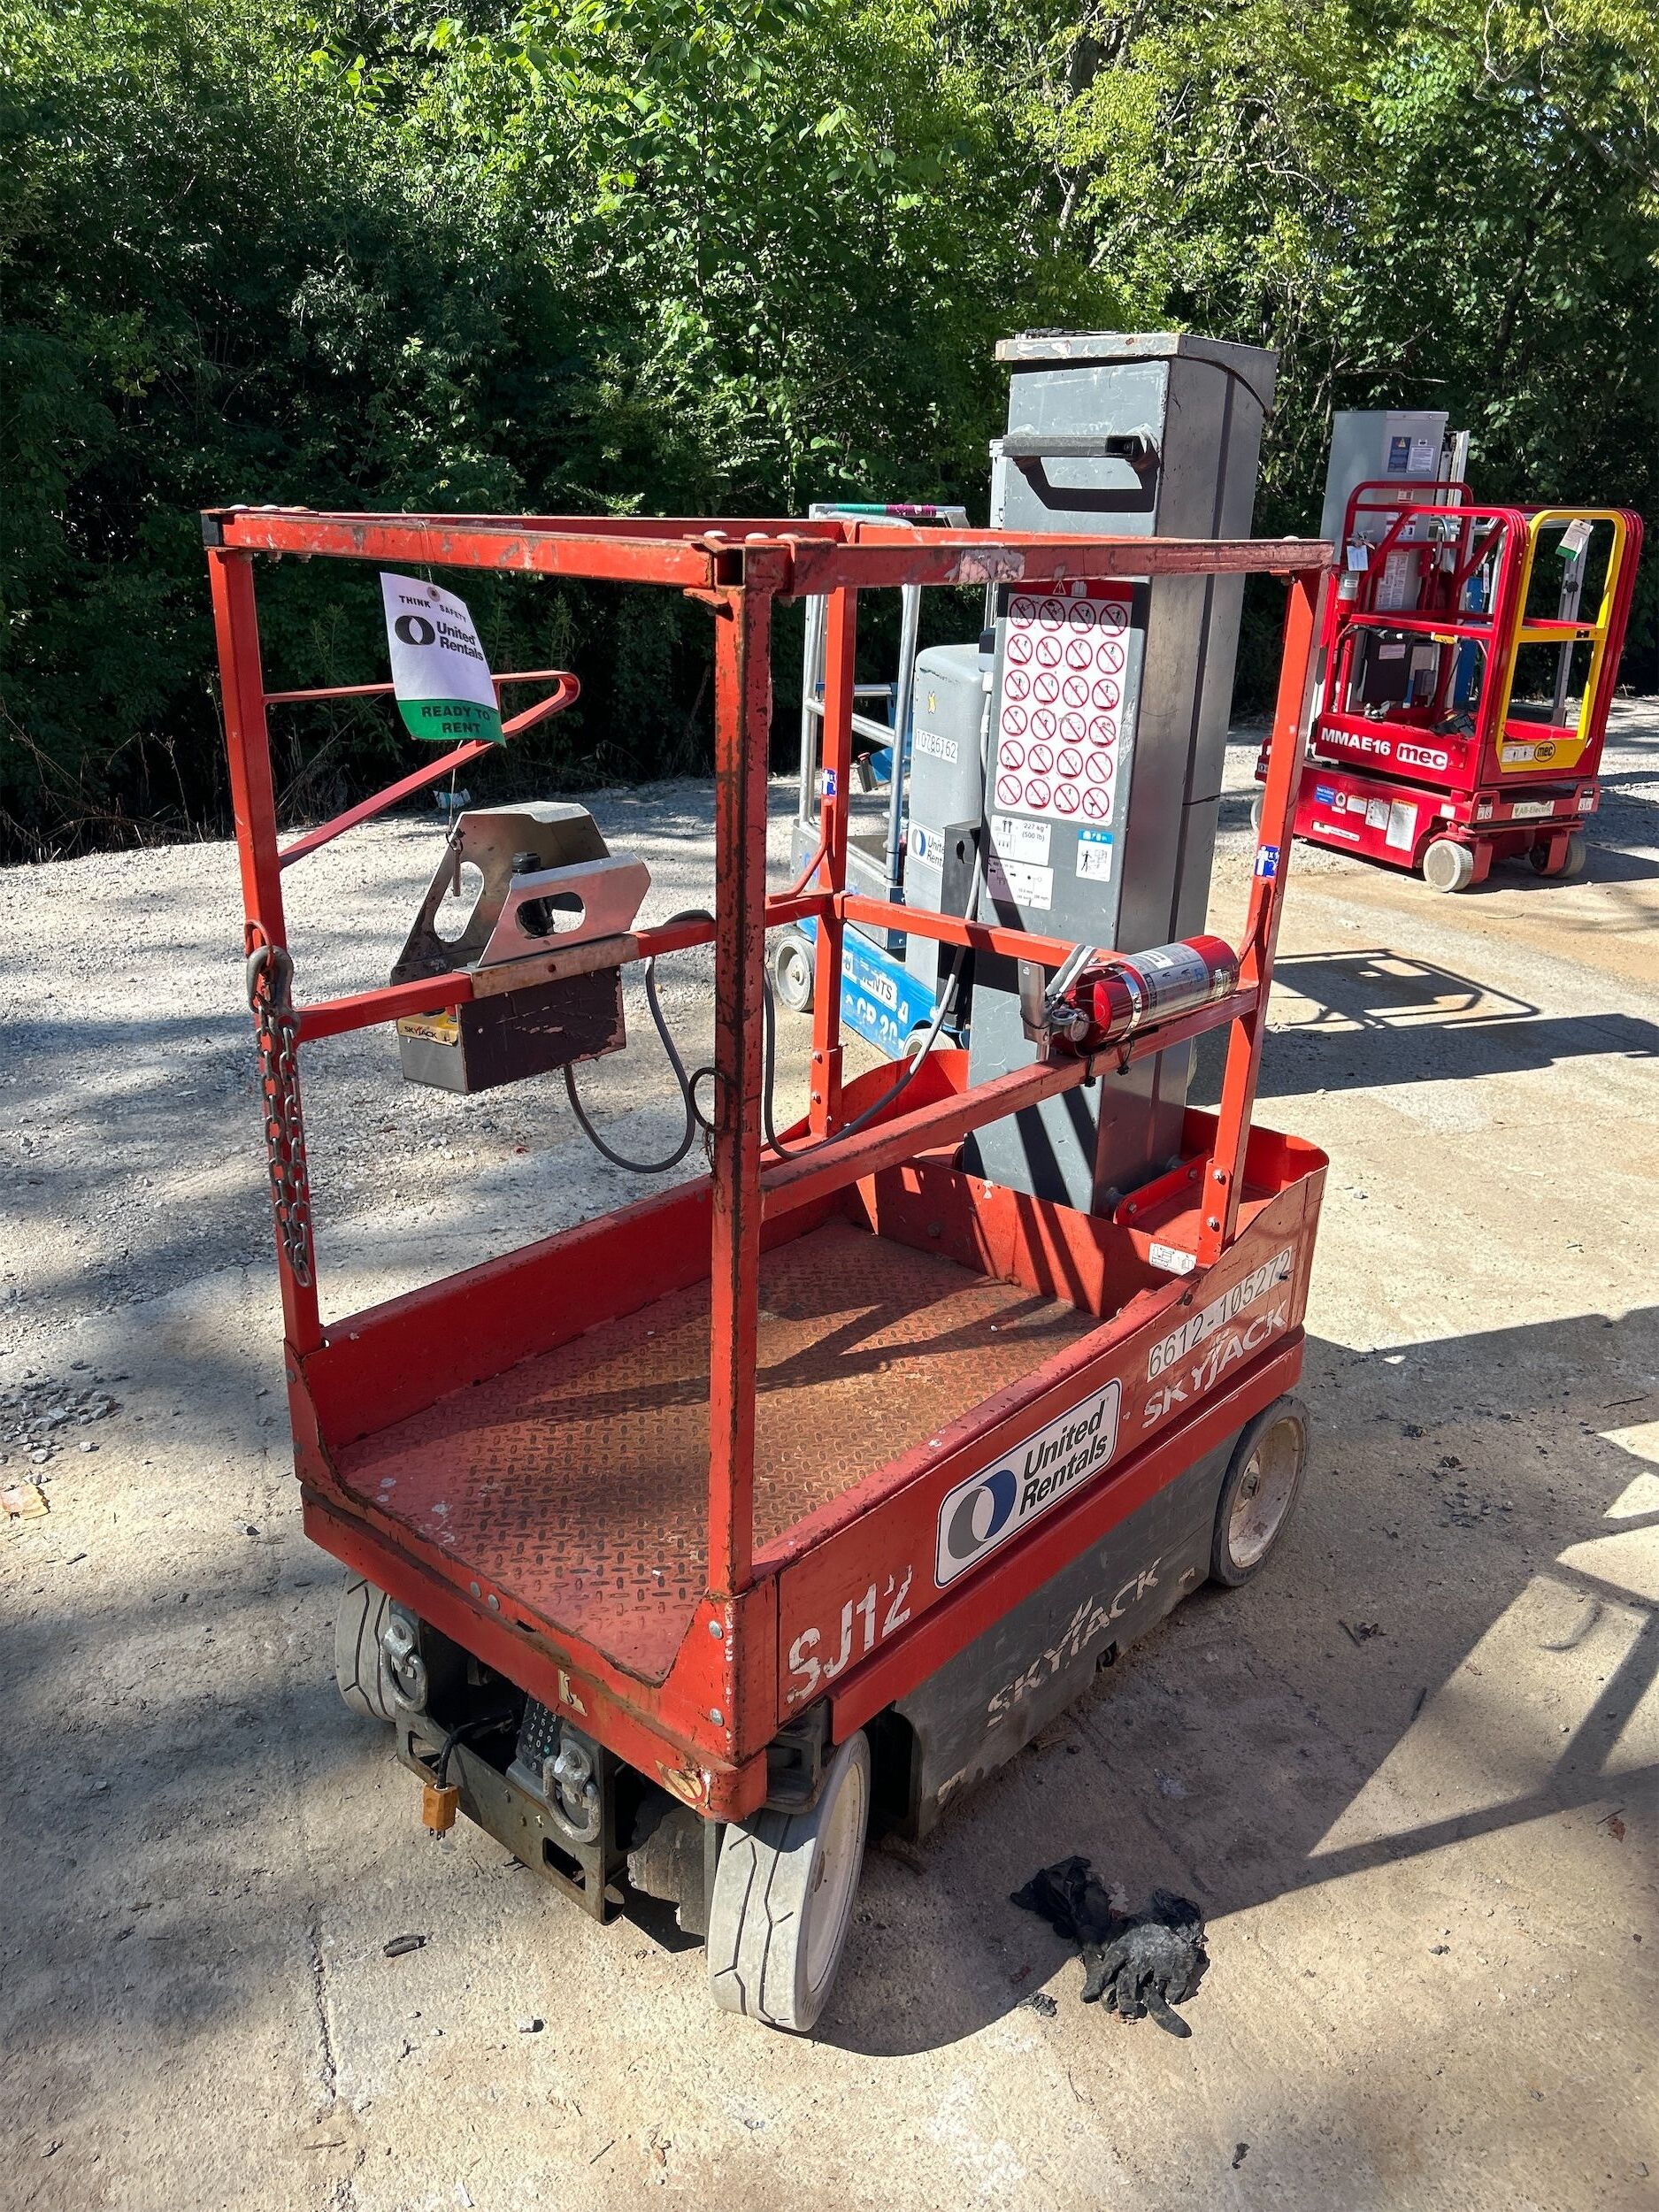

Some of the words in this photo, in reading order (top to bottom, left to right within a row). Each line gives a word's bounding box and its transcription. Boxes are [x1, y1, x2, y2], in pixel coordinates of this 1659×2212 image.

[398, 595, 431, 609] THINK
[439, 604, 467, 623] SAFETY
[436, 620, 476, 646] United
[439, 636, 484, 662] Rentals
[421, 705, 472, 718] READY
[476, 709, 491, 720] TO
[442, 721, 481, 733] RENT
[1321, 726, 1392, 757] MMAE16
[1398, 745, 1447, 767] mec
[927, 835, 945, 855] Unite
[1022, 830, 1036, 840] (500
[1036, 833, 1045, 841] lb)
[926, 849, 942, 867] Rent
[403, 1025, 438, 1039] SKYJACK
[1149, 1249, 1292, 1379] 6612-105272
[1142, 1300, 1287, 1429] SKYJACK
[1024, 1400, 1106, 1480] United
[1019, 1433, 1108, 1517] Rentals
[787, 1564, 913, 1704] SJ12
[987, 1557, 1162, 1727] SKYJACK
